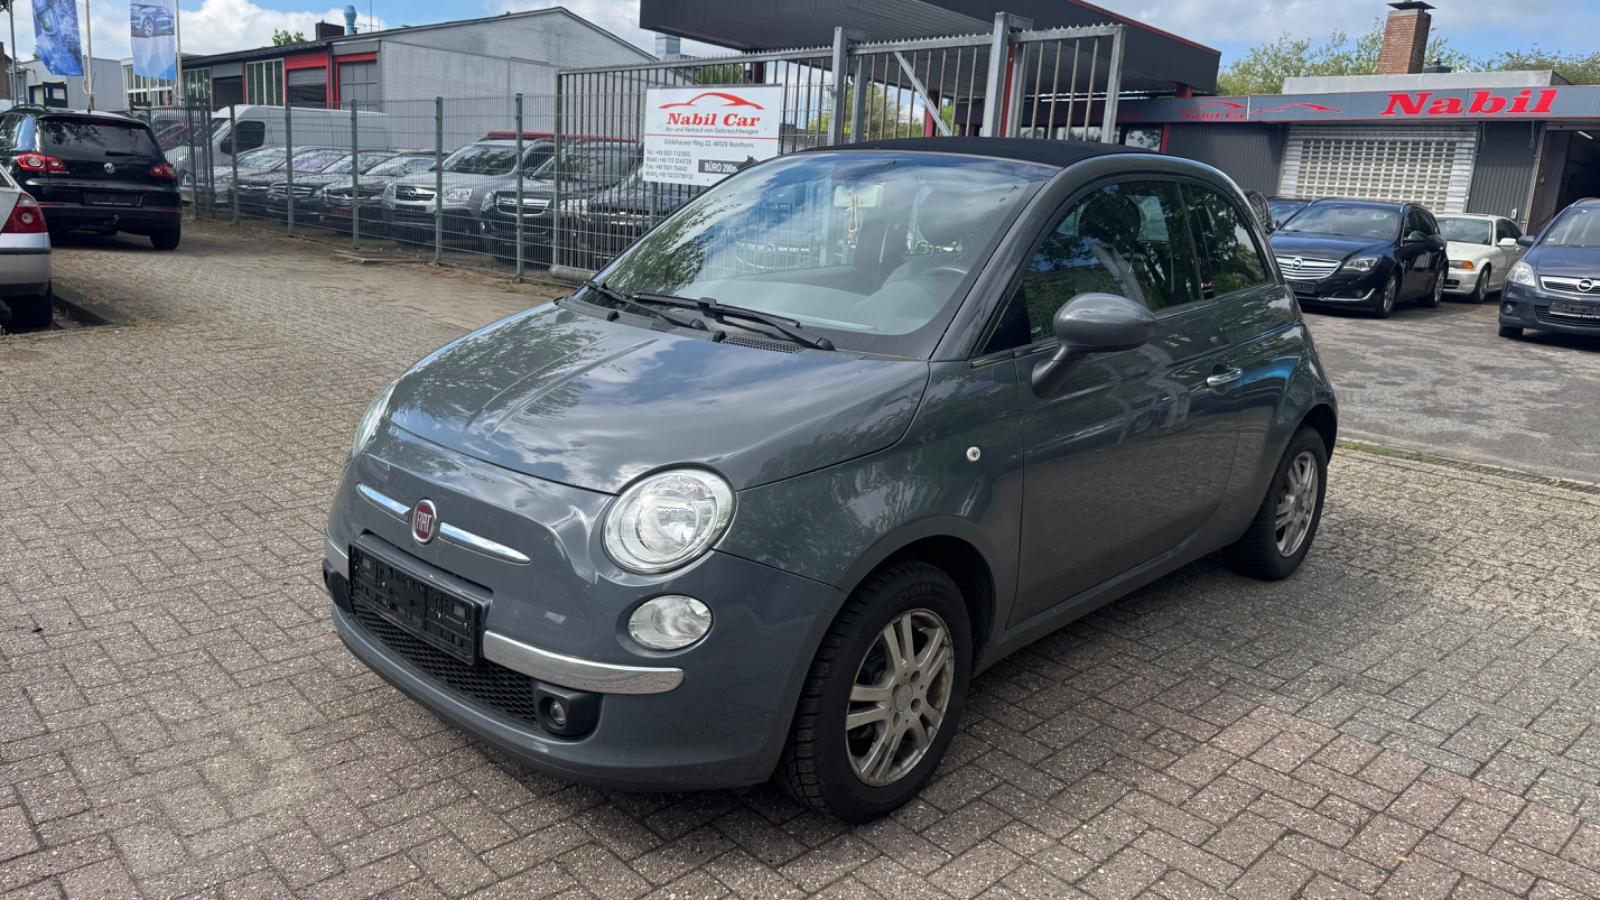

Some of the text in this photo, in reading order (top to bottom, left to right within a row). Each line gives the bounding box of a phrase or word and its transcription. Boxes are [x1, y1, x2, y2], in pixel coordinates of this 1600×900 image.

[1380, 89, 1559, 116] Nabil
[667, 112, 761, 127] Nabil Car
[693, 139, 703, 147] Weg
[704, 161, 721, 172] BÜRO
[416, 511, 432, 533] FIAT
